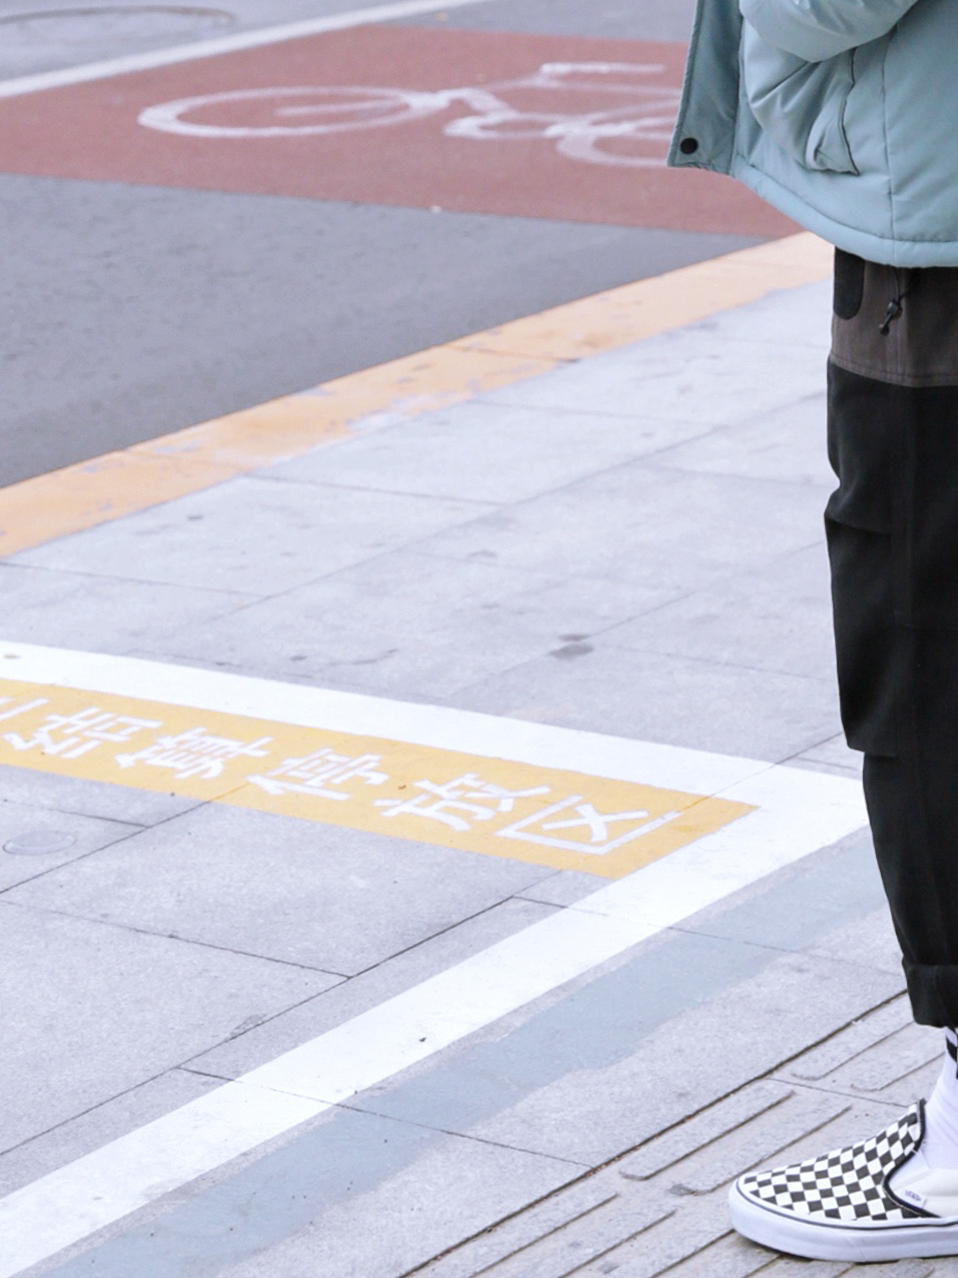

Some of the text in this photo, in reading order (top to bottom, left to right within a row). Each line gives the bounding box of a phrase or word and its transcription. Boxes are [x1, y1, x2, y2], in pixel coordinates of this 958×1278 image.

[0, 696, 682, 856] 结算停放区
